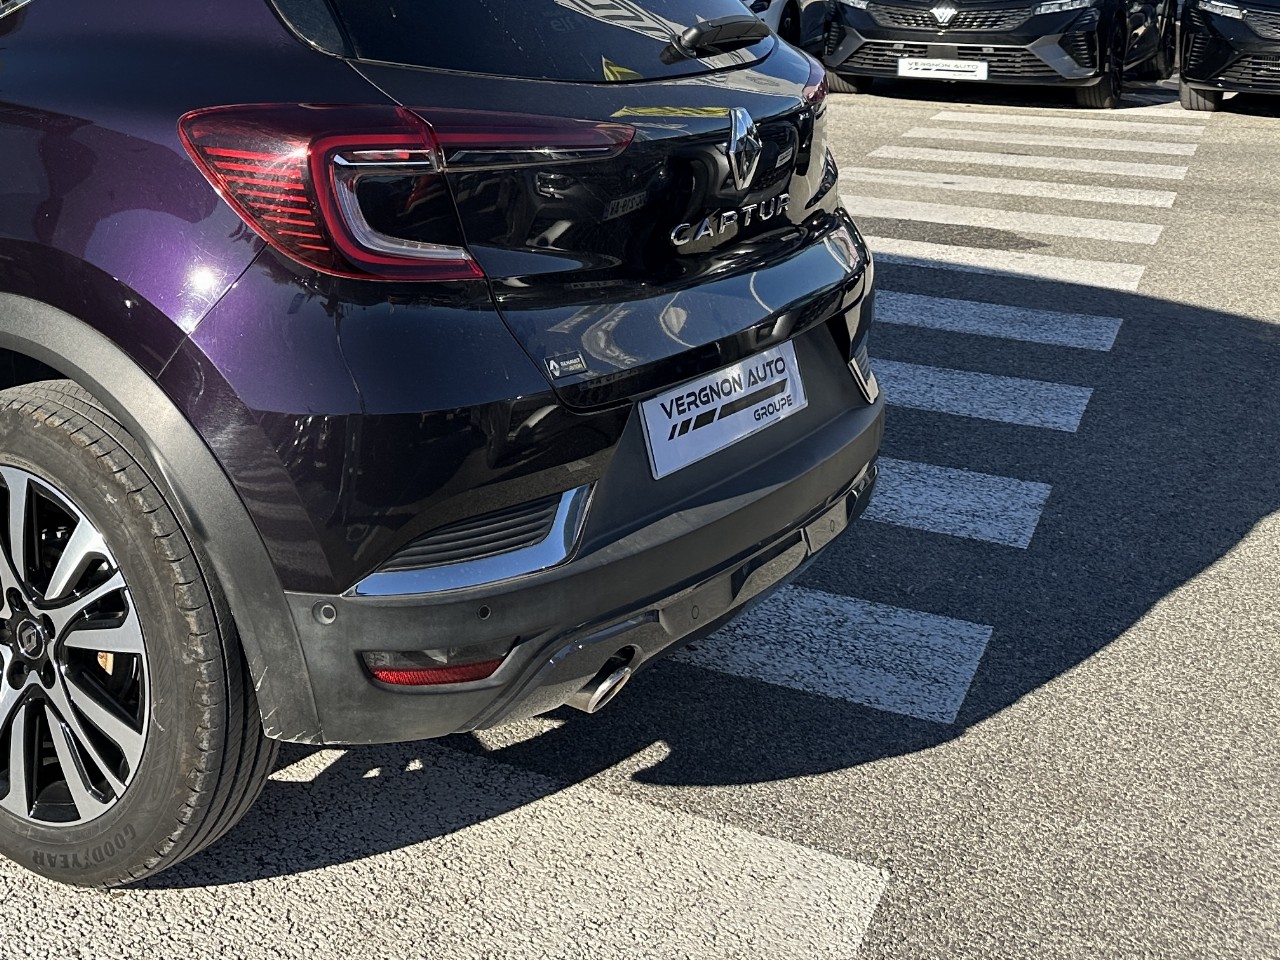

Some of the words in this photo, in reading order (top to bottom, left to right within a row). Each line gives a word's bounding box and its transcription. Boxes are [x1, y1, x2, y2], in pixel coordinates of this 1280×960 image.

[670, 193, 790, 246] CAPTUR
[659, 378, 743, 420] VERGNON
[747, 355, 786, 388] AUTO
[753, 395, 793, 423] GROUPE
